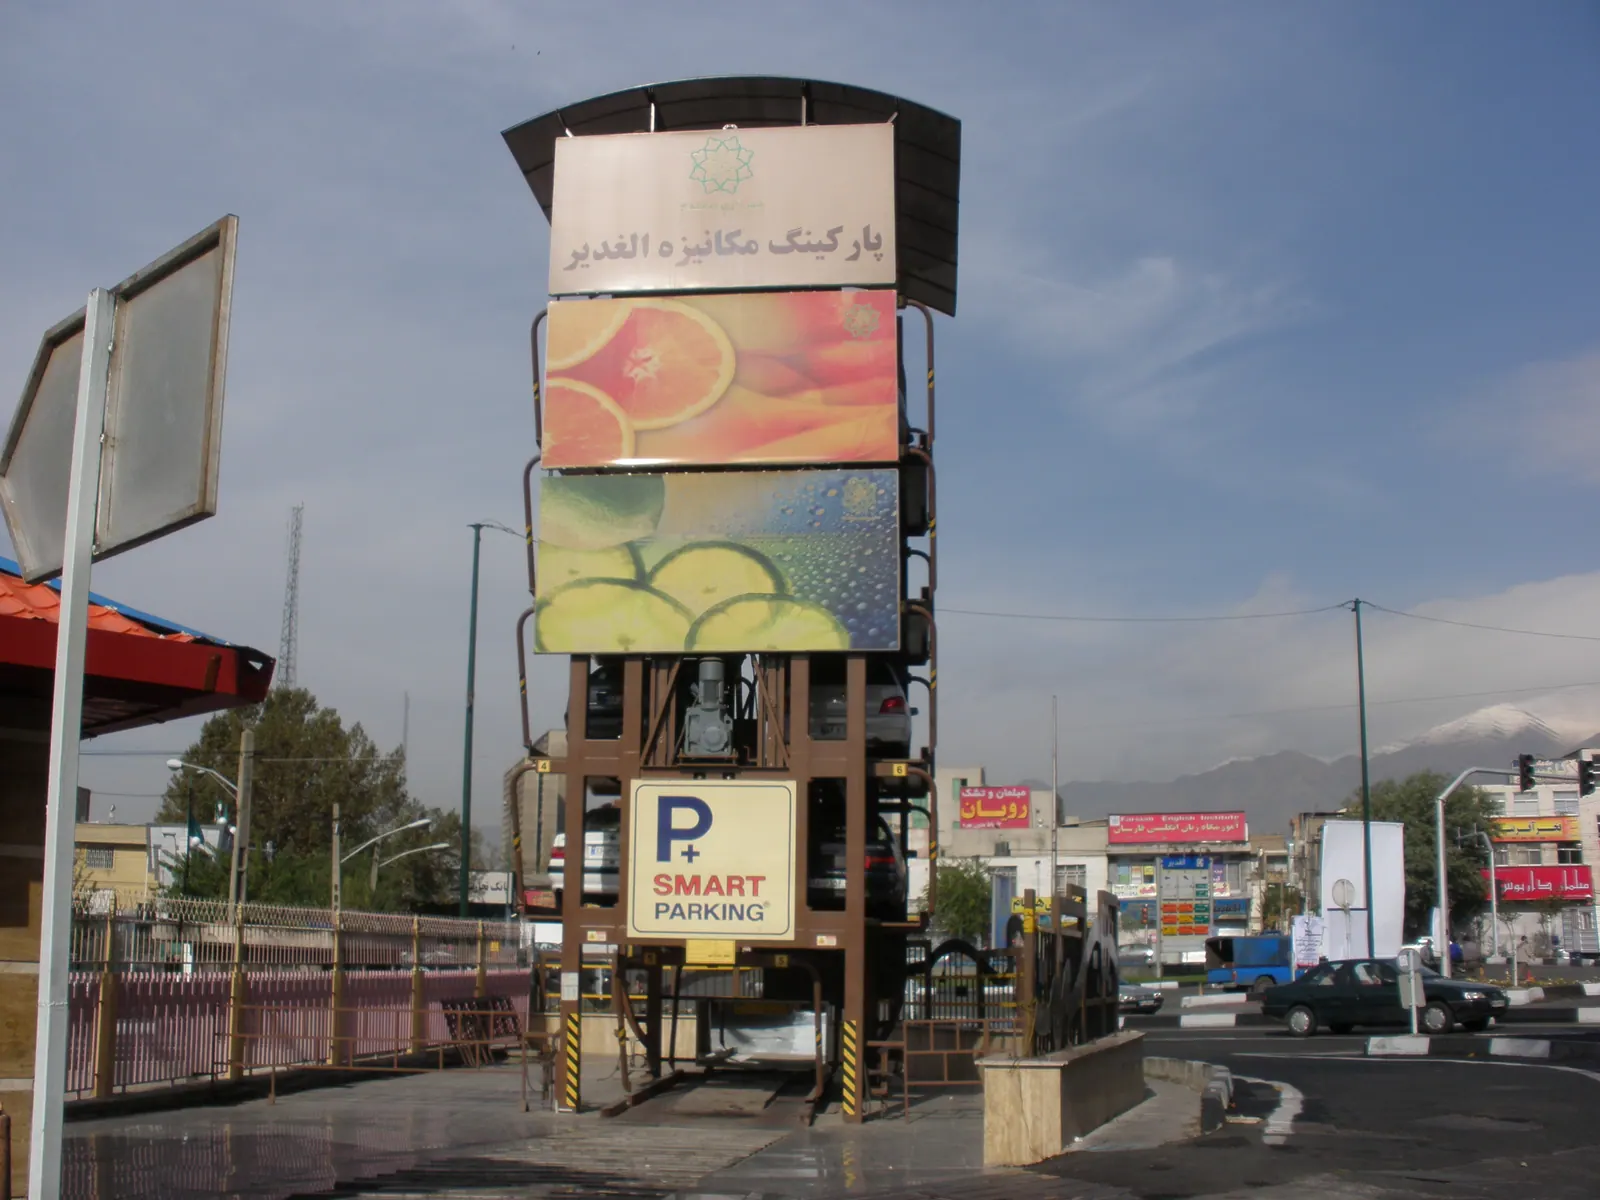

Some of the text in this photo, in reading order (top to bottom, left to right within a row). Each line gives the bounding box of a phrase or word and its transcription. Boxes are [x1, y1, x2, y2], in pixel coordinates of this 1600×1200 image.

[562, 223, 884, 271] پارکینگ مکانیزه الغدیر
[960, 799, 1029, 822] رویان
[653, 873, 766, 897] SMART
[655, 902, 764, 921] PARKING
